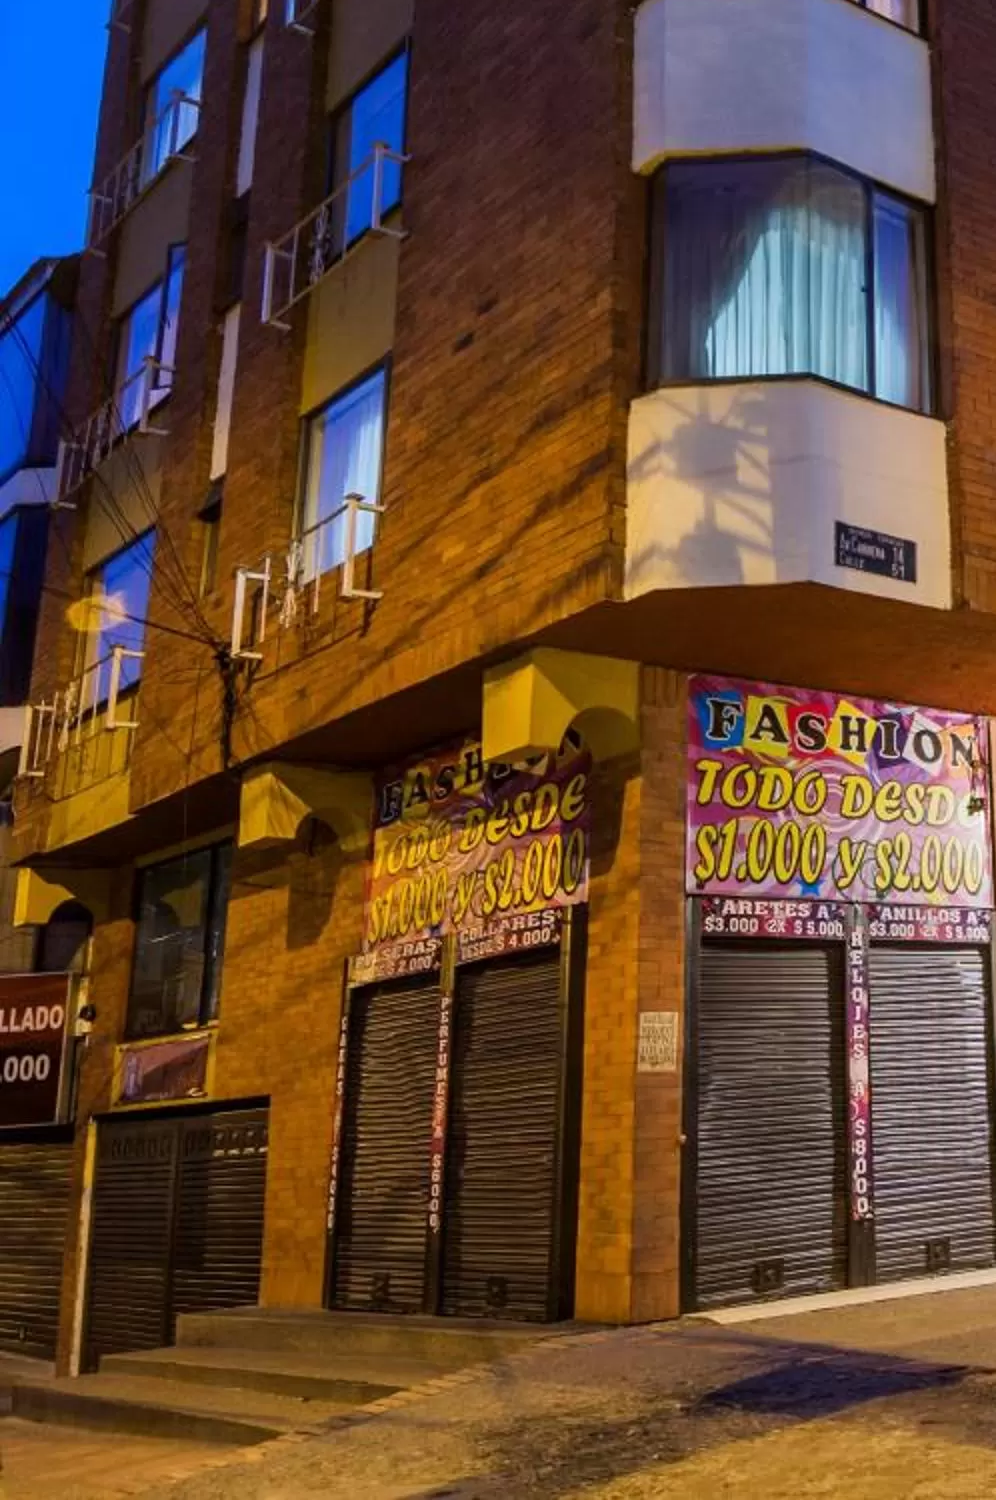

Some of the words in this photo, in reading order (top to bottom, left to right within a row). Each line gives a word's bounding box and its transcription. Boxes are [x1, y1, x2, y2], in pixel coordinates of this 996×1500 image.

[705, 696, 976, 767] FASHION
[694, 759, 827, 816] TODO
[372, 818, 451, 880] TODO
[704, 914, 759, 933] $3.000
